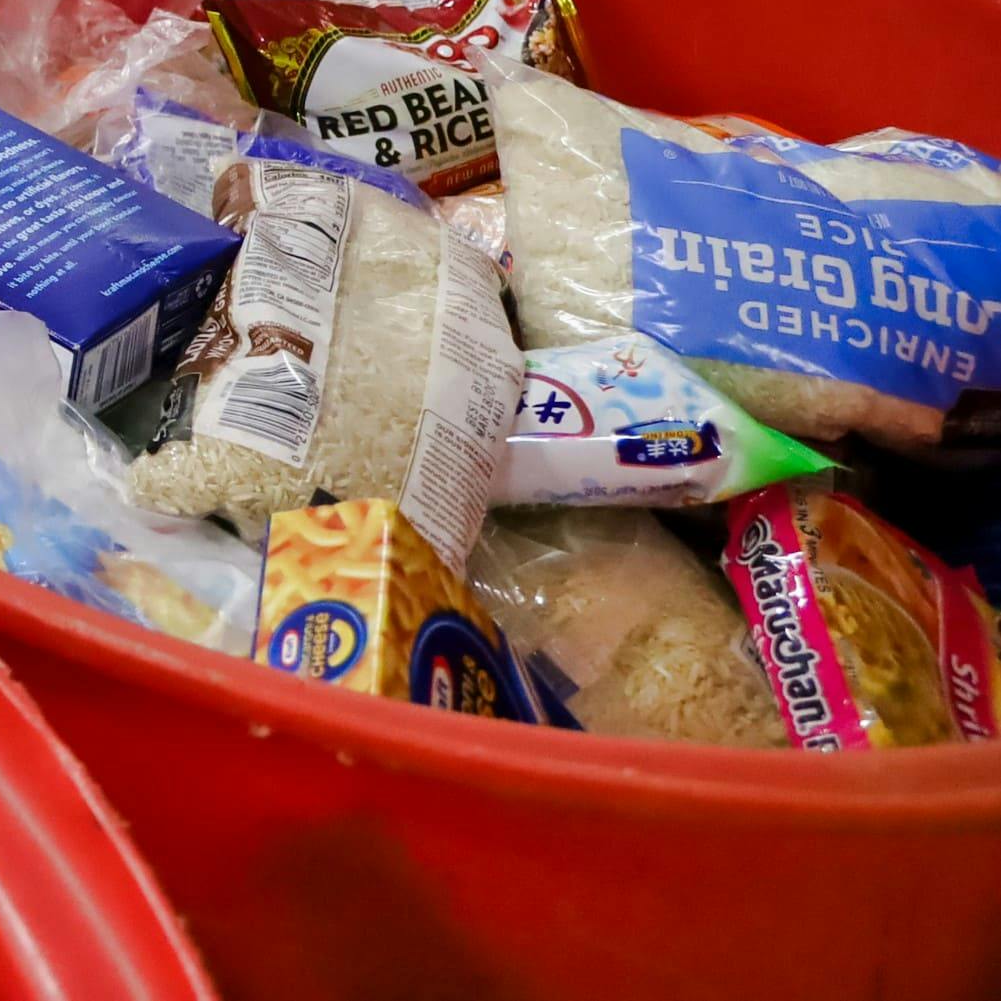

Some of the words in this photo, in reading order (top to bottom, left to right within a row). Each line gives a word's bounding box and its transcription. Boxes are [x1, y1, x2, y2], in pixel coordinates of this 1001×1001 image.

[380, 66, 443, 96] AUTHENTIC
[318, 103, 399, 141] RED
[375, 136, 401, 168] &
[412, 116, 496, 160] RICE
[18, 158, 33, 167] you
[2, 201, 16, 209] no
[16, 179, 53, 201] artificial
[49, 166, 86, 182] flavors,
[23, 207, 35, 215] or
[35, 195, 60, 208] dyes.
[3, 238, 18, 248] the
[16, 222, 43, 241] great
[40, 208, 66, 223] taste
[65, 199, 84, 211] you
[79, 187, 107, 201] know
[107, 178, 125, 189] and
[14, 270, 33, 283] bite
[30, 262, 45, 271] by
[60, 238, 78, 252] until
[77, 229, 95, 242] your
[651, 226, 857, 309] Grain
[27, 275, 58, 298] nothing
[65, 261, 77, 270] all.
[871, 255, 1001, 336] ong
[738, 300, 977, 382] ENRICHED
[465, 400, 482, 427] BEST
[475, 414, 488, 437] MAR
[795, 507, 810, 522] IN
[801, 522, 821, 541] 3
[749, 539, 832, 725] Maruchan
[953, 656, 987, 739] Shri
